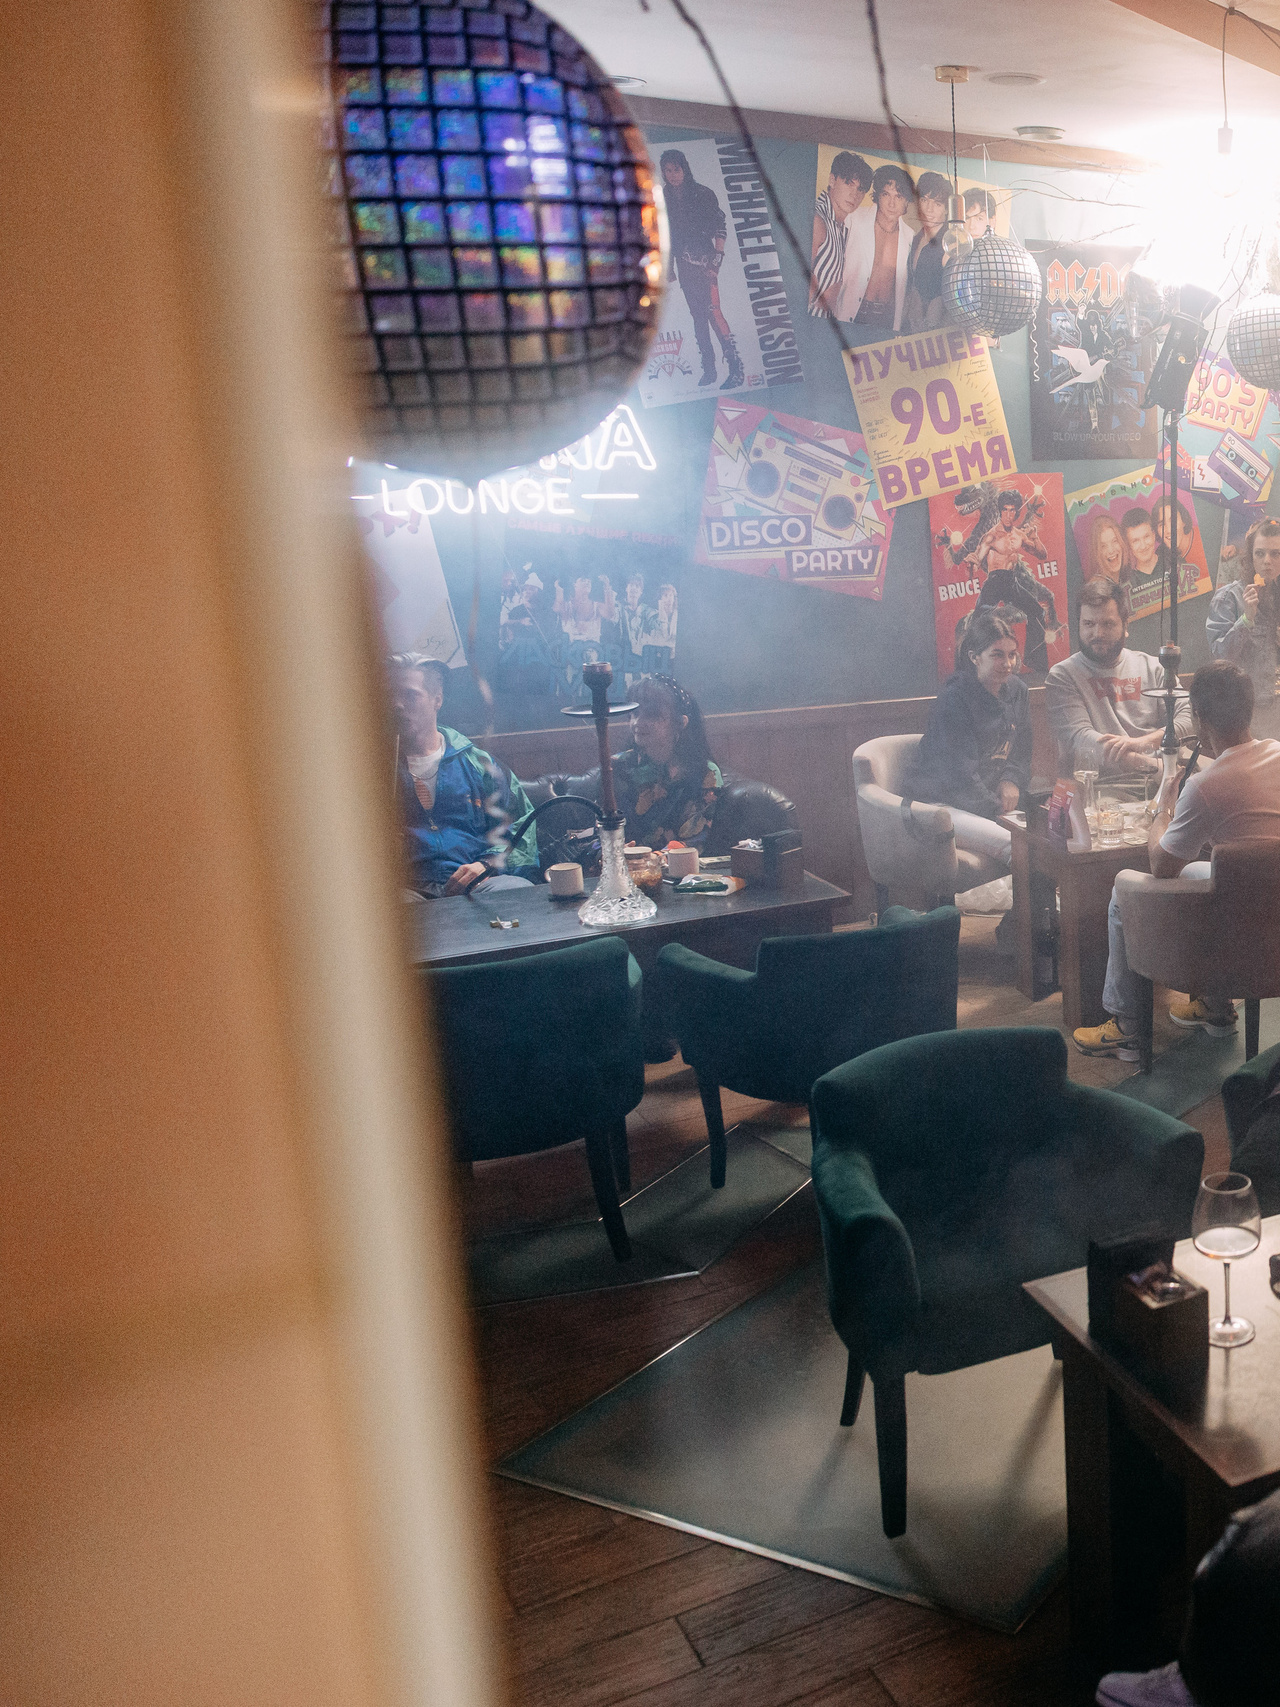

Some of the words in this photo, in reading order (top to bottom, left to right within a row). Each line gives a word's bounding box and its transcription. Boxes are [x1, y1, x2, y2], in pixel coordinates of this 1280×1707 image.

[715, 137, 777, 262] MICHAEL
[743, 261, 804, 388] JACKSON
[851, 330, 985, 385] ЛУЧШЕЕ
[1194, 361, 1256, 406] 90'S
[890, 378, 987, 445] 90-Е
[1188, 391, 1255, 429] PARTY
[1117, 432, 1141, 441] VIDEO
[877, 434, 1012, 504] ВРЕМЯ
[381, 478, 575, 515] LOUNGE
[710, 517, 806, 548] DISCO
[792, 549, 873, 573] PARTY
[938, 578, 982, 602] BRUCE
[1037, 561, 1059, 580] LEE
